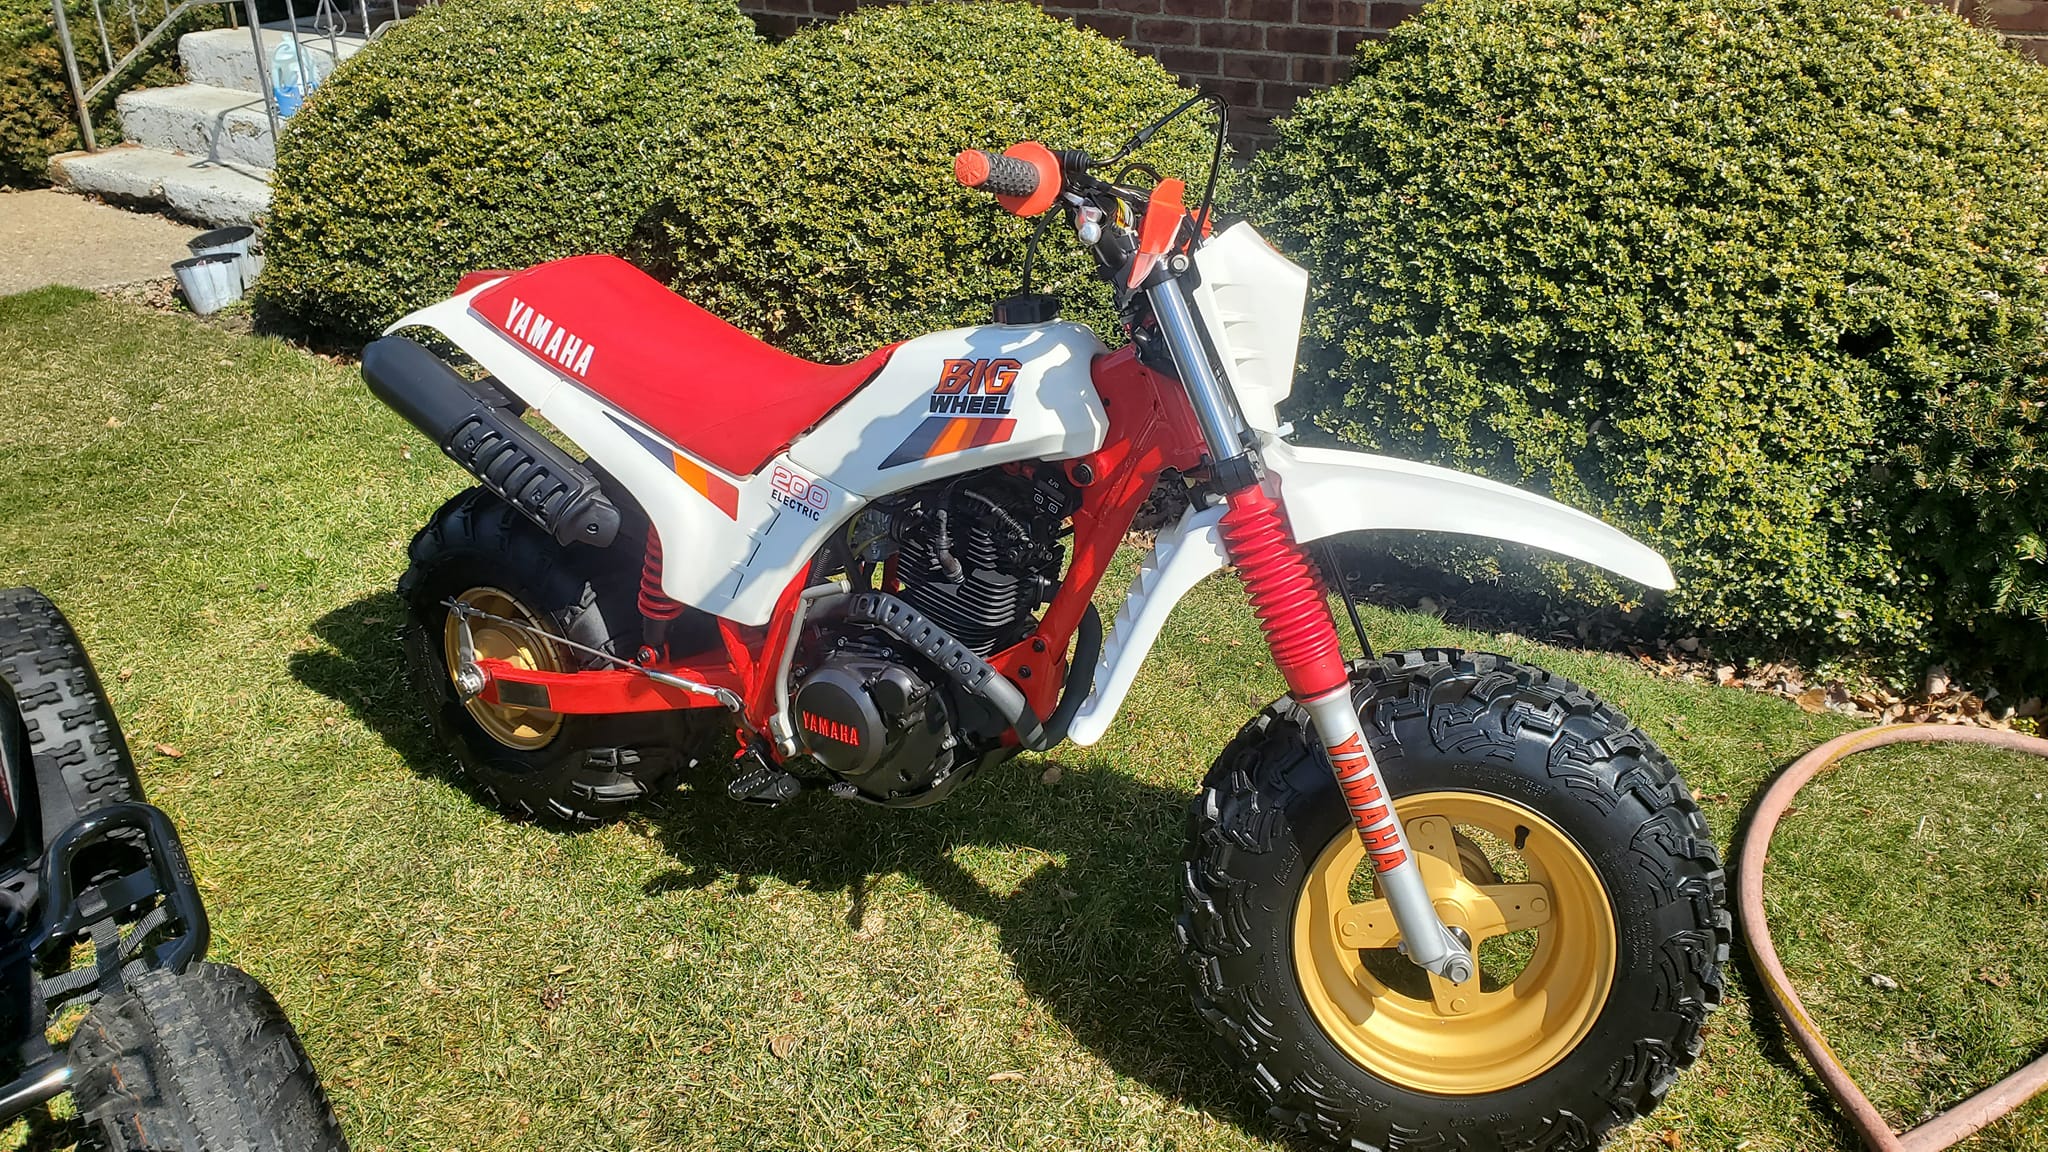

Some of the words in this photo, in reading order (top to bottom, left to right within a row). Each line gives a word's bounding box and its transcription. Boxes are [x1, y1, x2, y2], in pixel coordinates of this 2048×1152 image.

[505, 297, 595, 377] YAMAHA
[933, 358, 1022, 395] BIG
[929, 396, 1012, 415] WHEEL
[771, 465, 829, 510] 200
[771, 488, 821, 522] ELECTRIC
[802, 710, 860, 746] YAMAHA
[1327, 731, 1408, 874] YAMAHA
